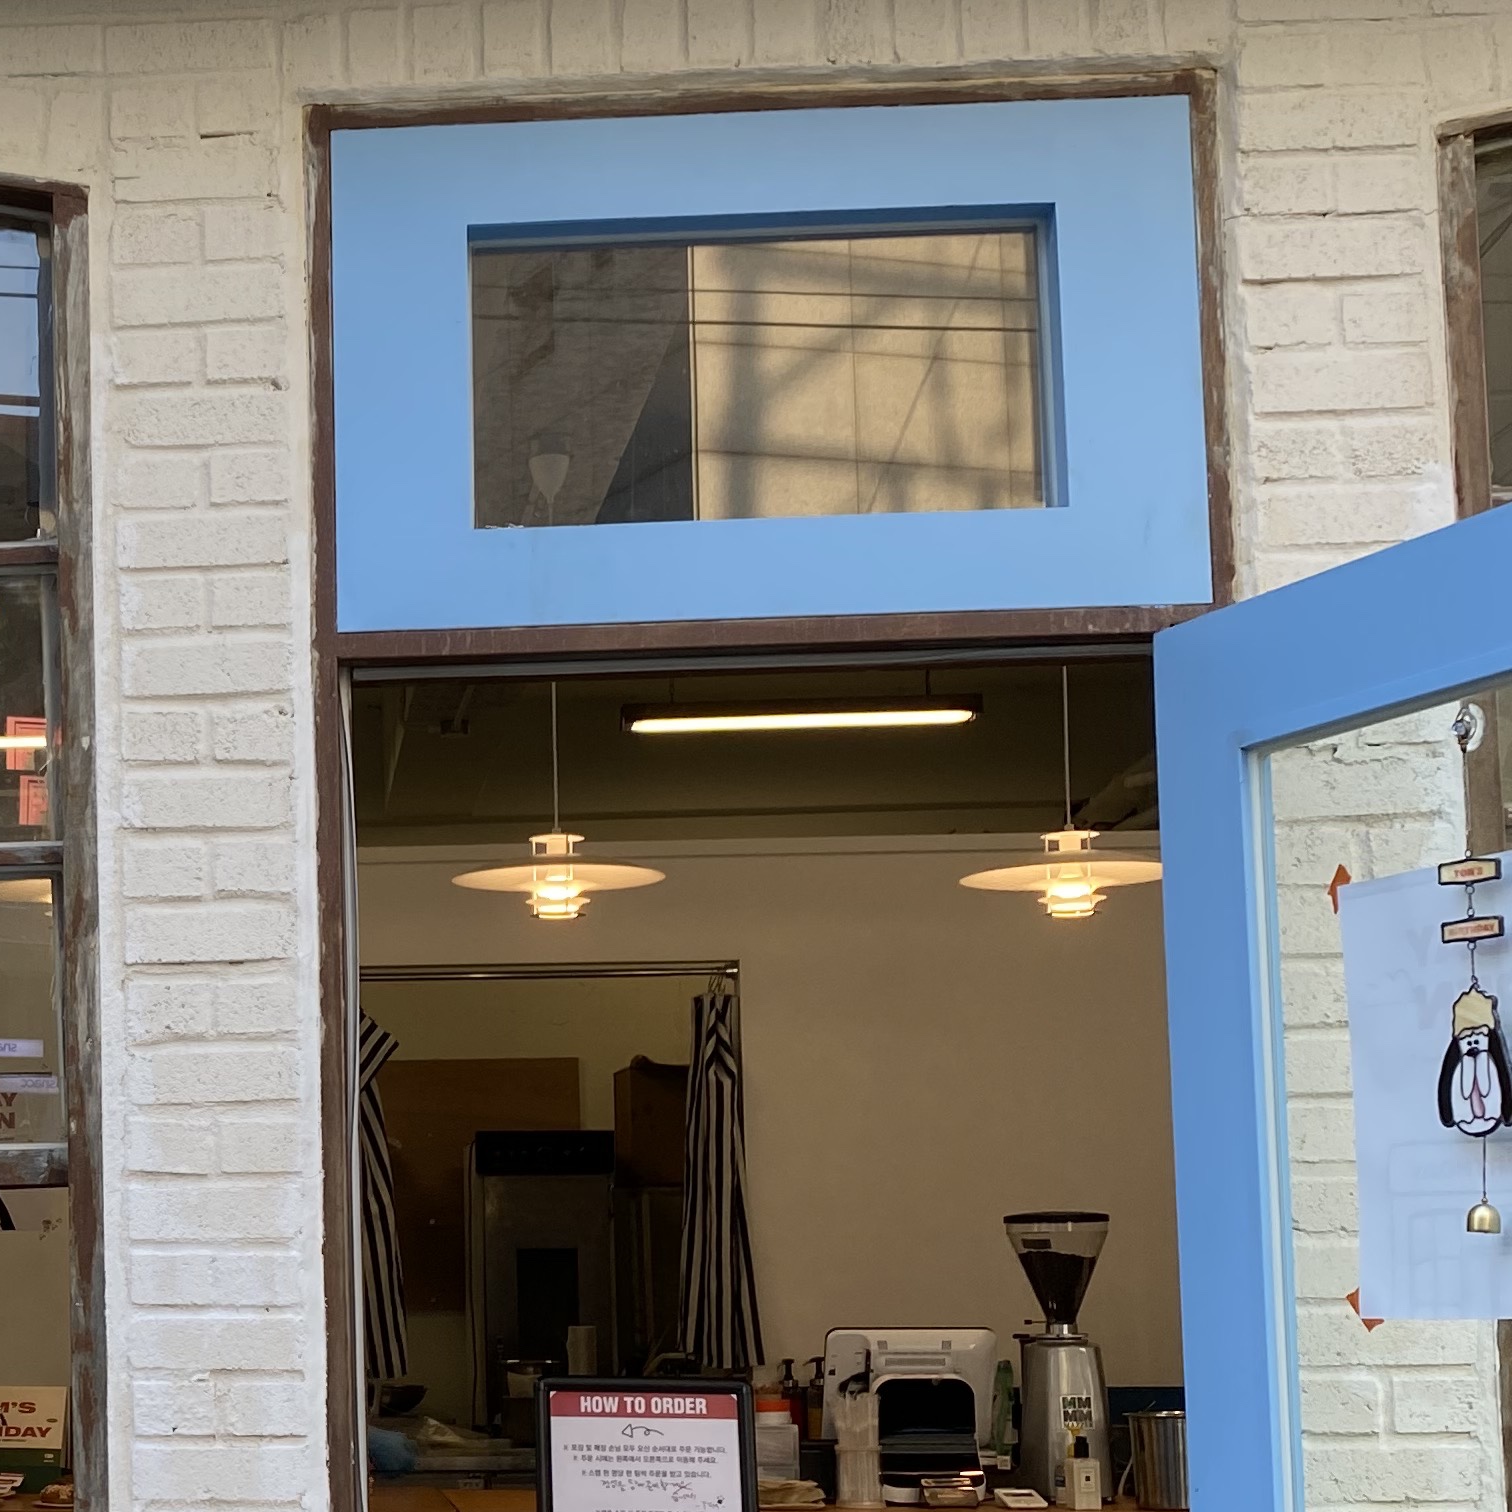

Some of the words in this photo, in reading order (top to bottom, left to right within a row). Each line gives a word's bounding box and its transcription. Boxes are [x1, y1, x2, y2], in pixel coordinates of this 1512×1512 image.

[580, 1396, 619, 1413] HOW
[623, 1397, 645, 1413] TO
[650, 1397, 707, 1415] ORDER
